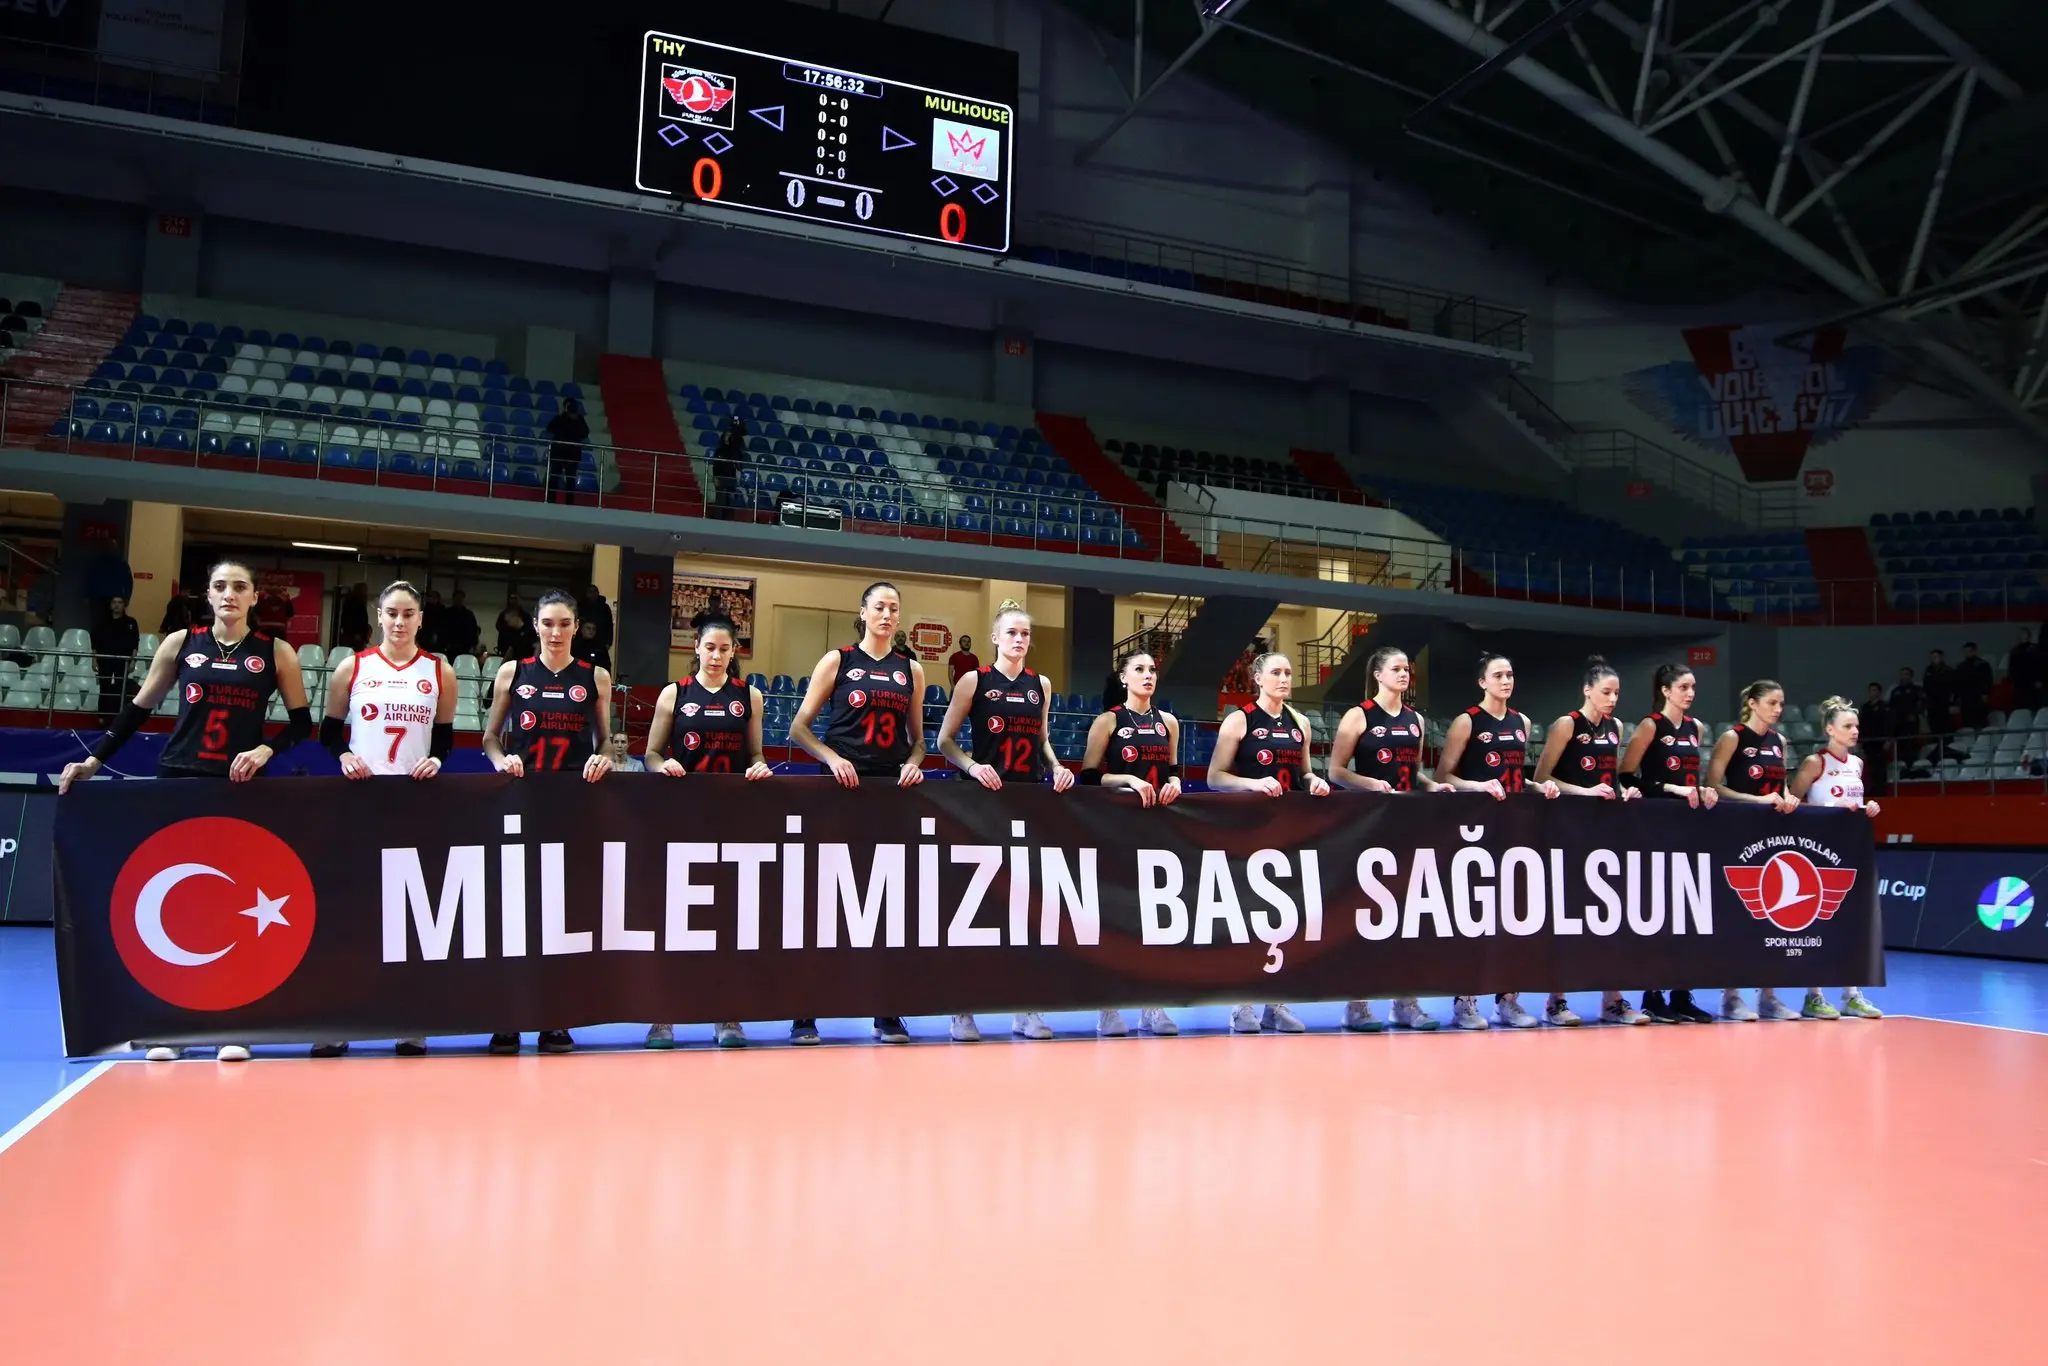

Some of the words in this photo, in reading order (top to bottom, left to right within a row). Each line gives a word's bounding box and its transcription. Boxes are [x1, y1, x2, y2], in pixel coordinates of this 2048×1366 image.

[653, 38, 685, 57] THY
[803, 69, 865, 94] 17:56:32
[819, 93, 828, 106] 0
[840, 98, 849, 110] 0
[925, 95, 1009, 124] MULHOUSE
[818, 111, 827, 124] 0
[839, 115, 848, 128] 0
[817, 128, 826, 141] 0
[838, 132, 847, 145] 0
[817, 146, 825, 159] 0
[838, 150, 847, 163] 0
[692, 157, 722, 200] 0
[816, 163, 825, 176] 0
[837, 167, 846, 180] 0
[786, 178, 806, 208] 0
[855, 191, 874, 220] 0
[940, 202, 967, 243] 0
[636, 578, 660, 590] 213
[1693, 651, 1712, 661] 212
[208, 683, 260, 699] TURKISH
[870, 689, 909, 705] TURKISH
[384, 703, 432, 716] TURKISH
[870, 698, 908, 713] AIRLINES
[384, 712, 430, 725] AIRLINES
[541, 712, 585, 721] TURKISH
[203, 709, 230, 750] 5
[861, 711, 896, 749] 13
[384, 726, 408, 764] 7
[529, 736, 571, 772] 17
[999, 736, 1033, 774] 12
[1738, 840, 1769, 863] TÜRK
[1766, 835, 1796, 849] HAVA
[1797, 836, 1842, 867] YOLLARI
[381, 814, 1101, 963] MİLLETİMİZİN
[1137, 848, 1324, 974] BAŞI
[1355, 824, 1714, 942] SAĞOLSUN
[1890, 880, 1926, 902] Cup
[1764, 937, 1788, 947] SPOR
[1789, 935, 1823, 947] KULÜBÜ
[1785, 948, 1803, 957] 1979
